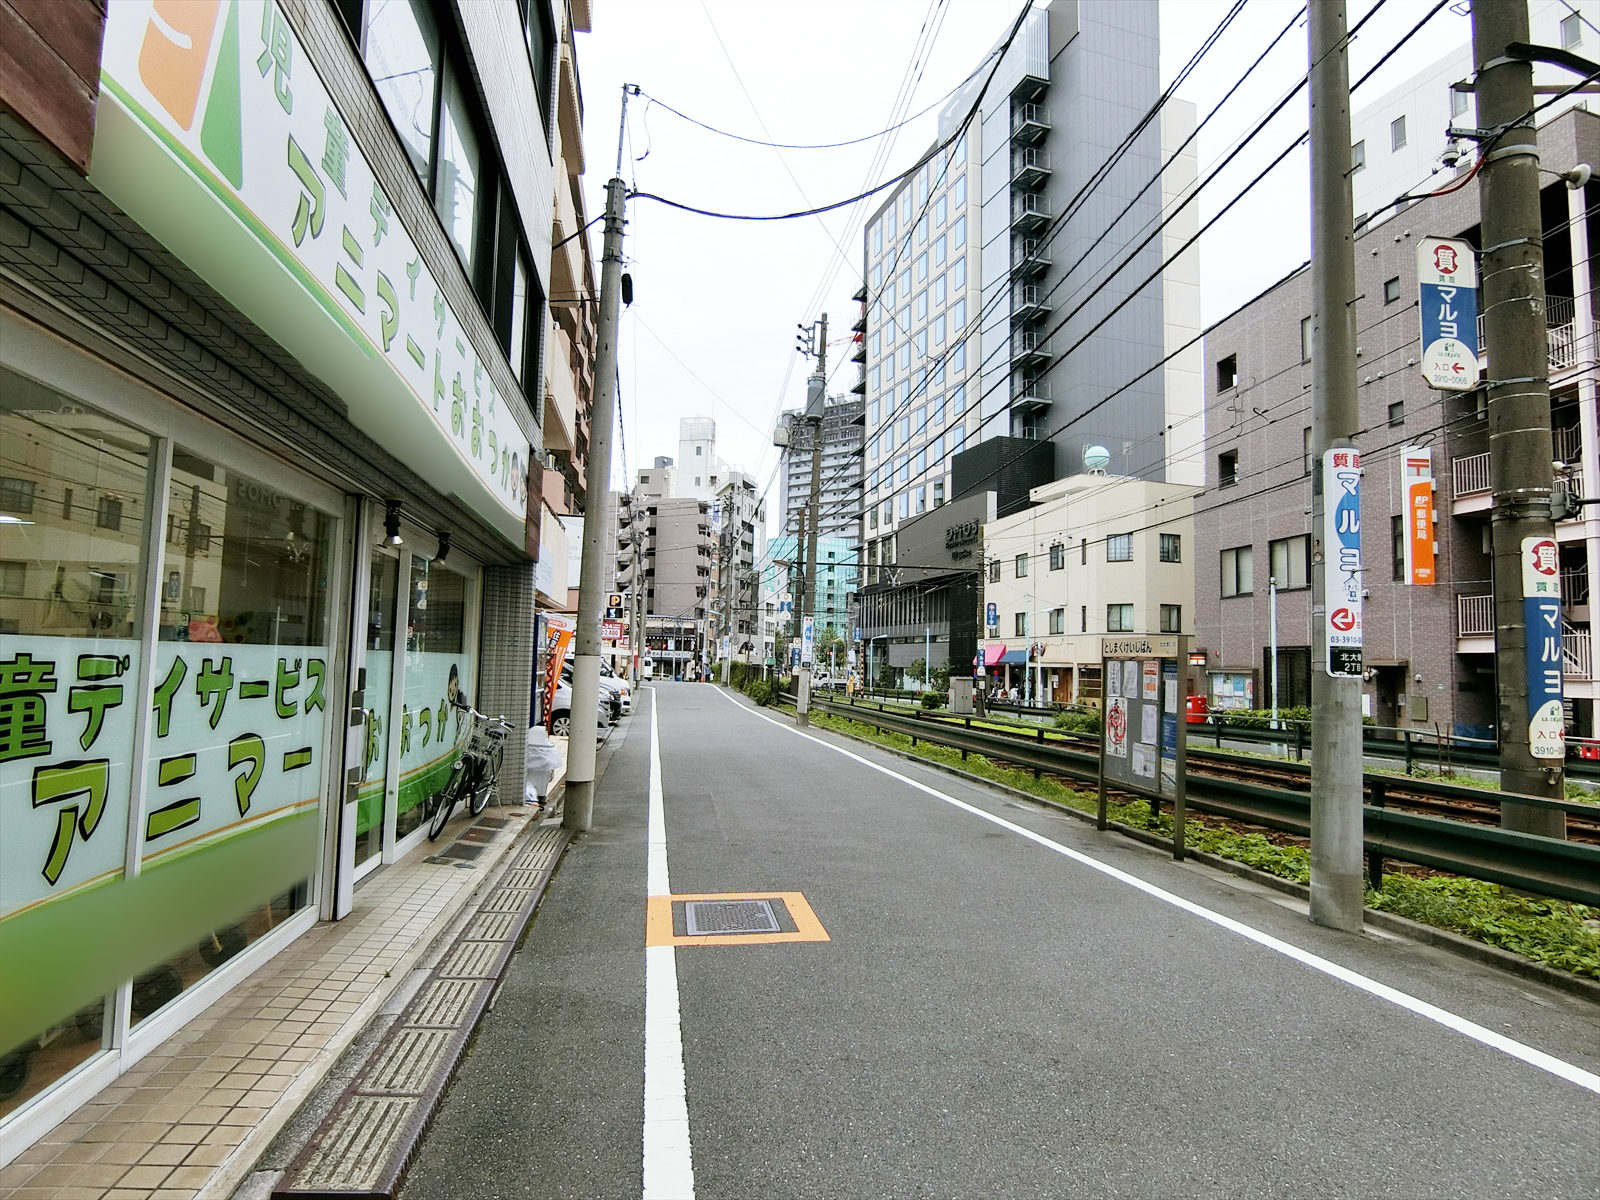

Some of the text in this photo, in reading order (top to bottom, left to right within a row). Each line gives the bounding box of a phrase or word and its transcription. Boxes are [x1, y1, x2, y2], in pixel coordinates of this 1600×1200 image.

[287, 131, 511, 493] アニマートおおつか
[1436, 285, 1459, 339] マルヨ
[1434, 362, 1450, 373] 入口
[1336, 472, 1360, 572] マルヨ
[1416, 508, 1428, 541] 郵便局
[610, 595, 621, 606] P
[1539, 604, 1561, 694] マルヨ
[1537, 731, 1557, 740] 入口
